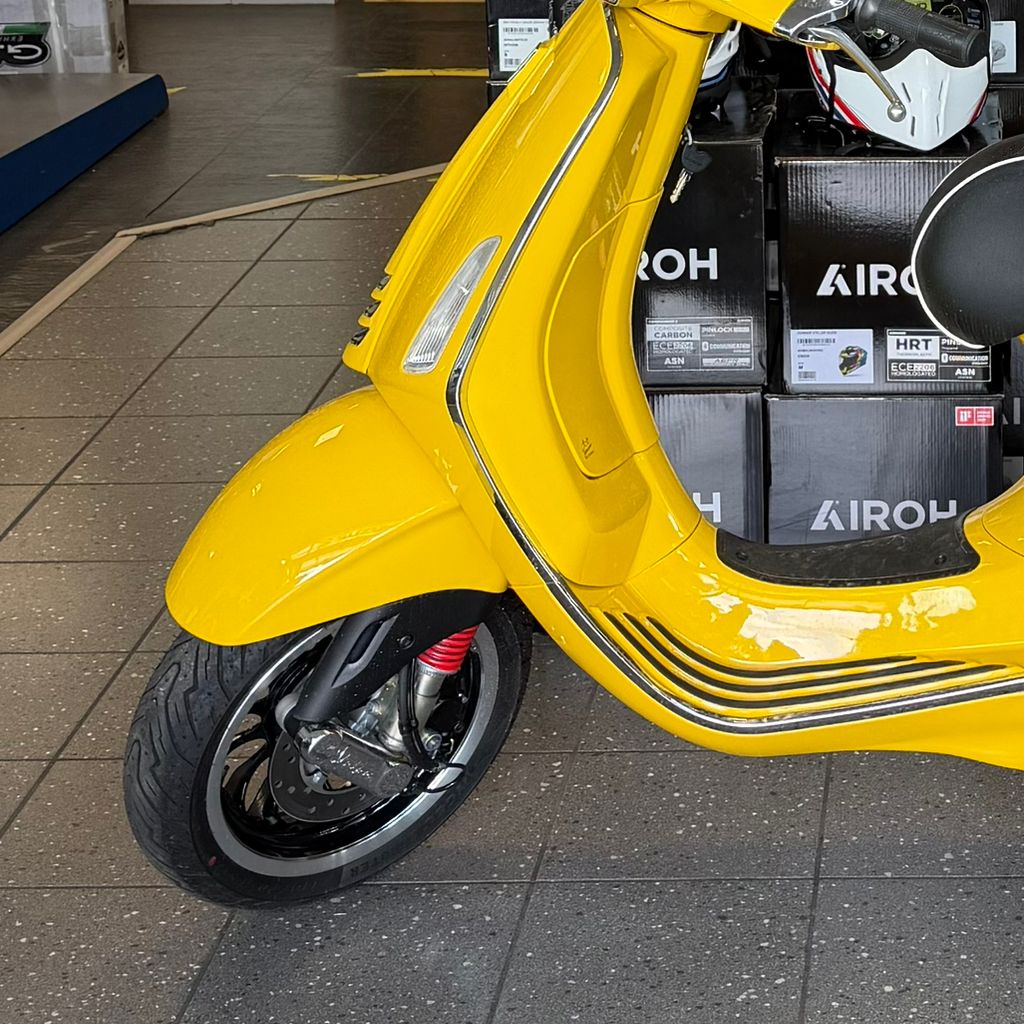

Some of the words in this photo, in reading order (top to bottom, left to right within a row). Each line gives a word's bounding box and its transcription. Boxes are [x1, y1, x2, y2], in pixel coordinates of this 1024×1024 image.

[654, 331, 693, 339] CARBON
[896, 338, 932, 351] HRT
[664, 357, 686, 366] ASN
[955, 367, 976, 377] ASN
